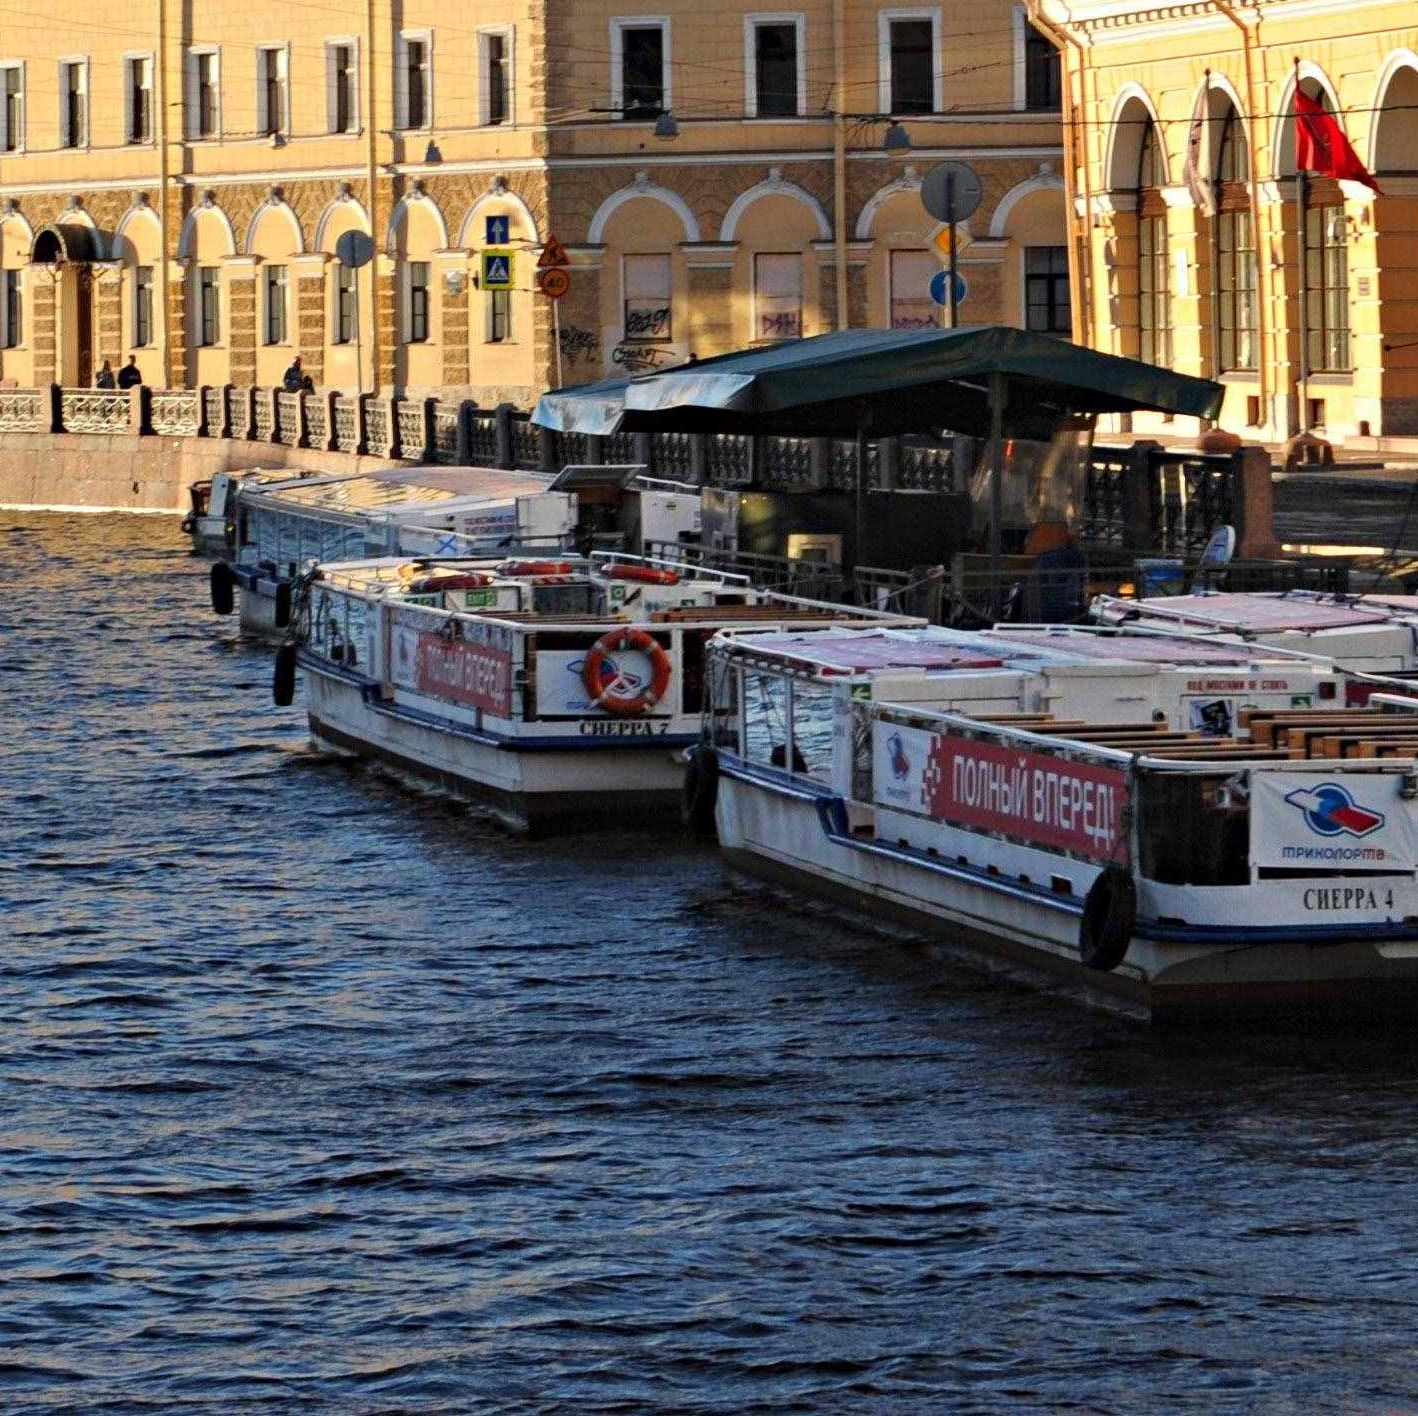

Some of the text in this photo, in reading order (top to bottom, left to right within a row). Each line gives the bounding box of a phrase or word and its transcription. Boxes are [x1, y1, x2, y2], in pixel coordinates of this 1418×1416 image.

[659, 722, 670, 735] 7
[951, 755, 1116, 852] ПОЛНЫЙ ВПЕРЕД!
[1385, 889, 1395, 909] 4
